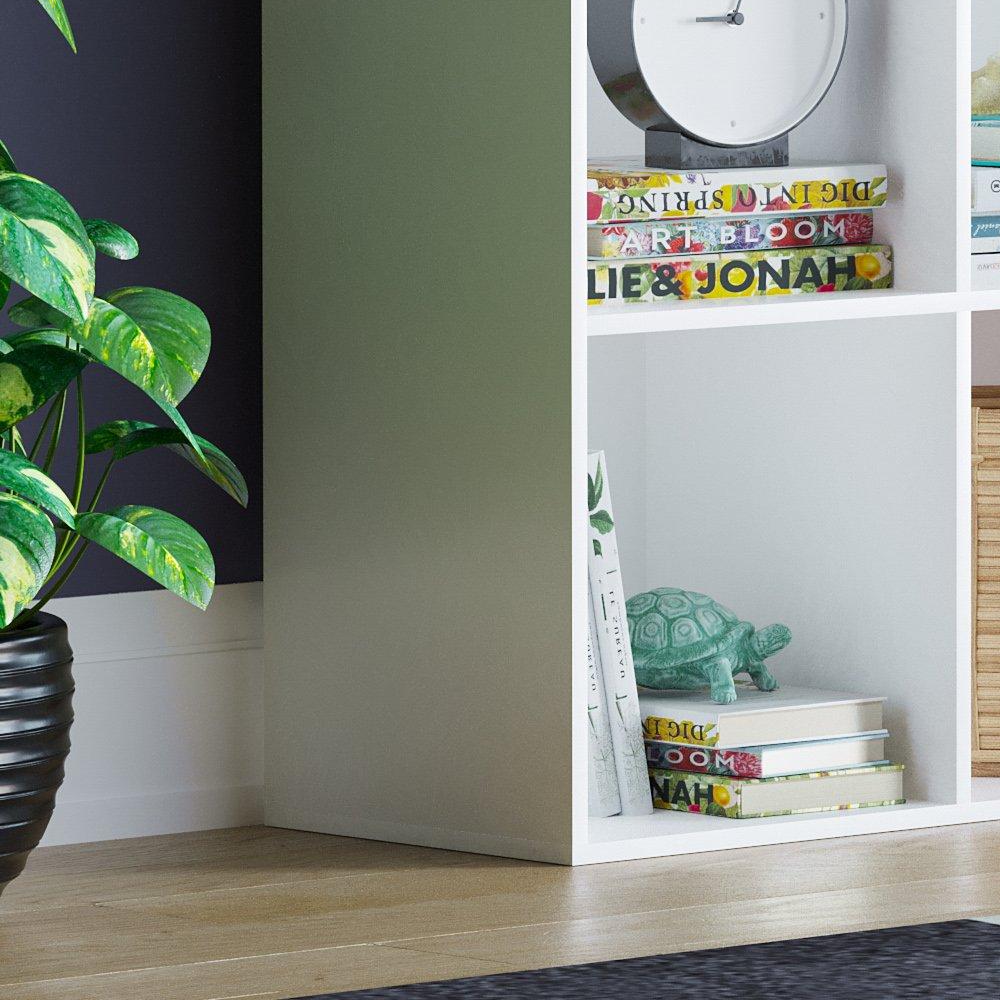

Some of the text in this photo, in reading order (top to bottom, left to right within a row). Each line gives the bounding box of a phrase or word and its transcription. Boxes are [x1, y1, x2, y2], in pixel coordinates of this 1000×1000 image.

[617, 181, 871, 214] DIG INTO SPRING
[620, 218, 847, 252] ART BLOOM
[697, 255, 856, 295] JONAH
[668, 721, 704, 741] DIG
